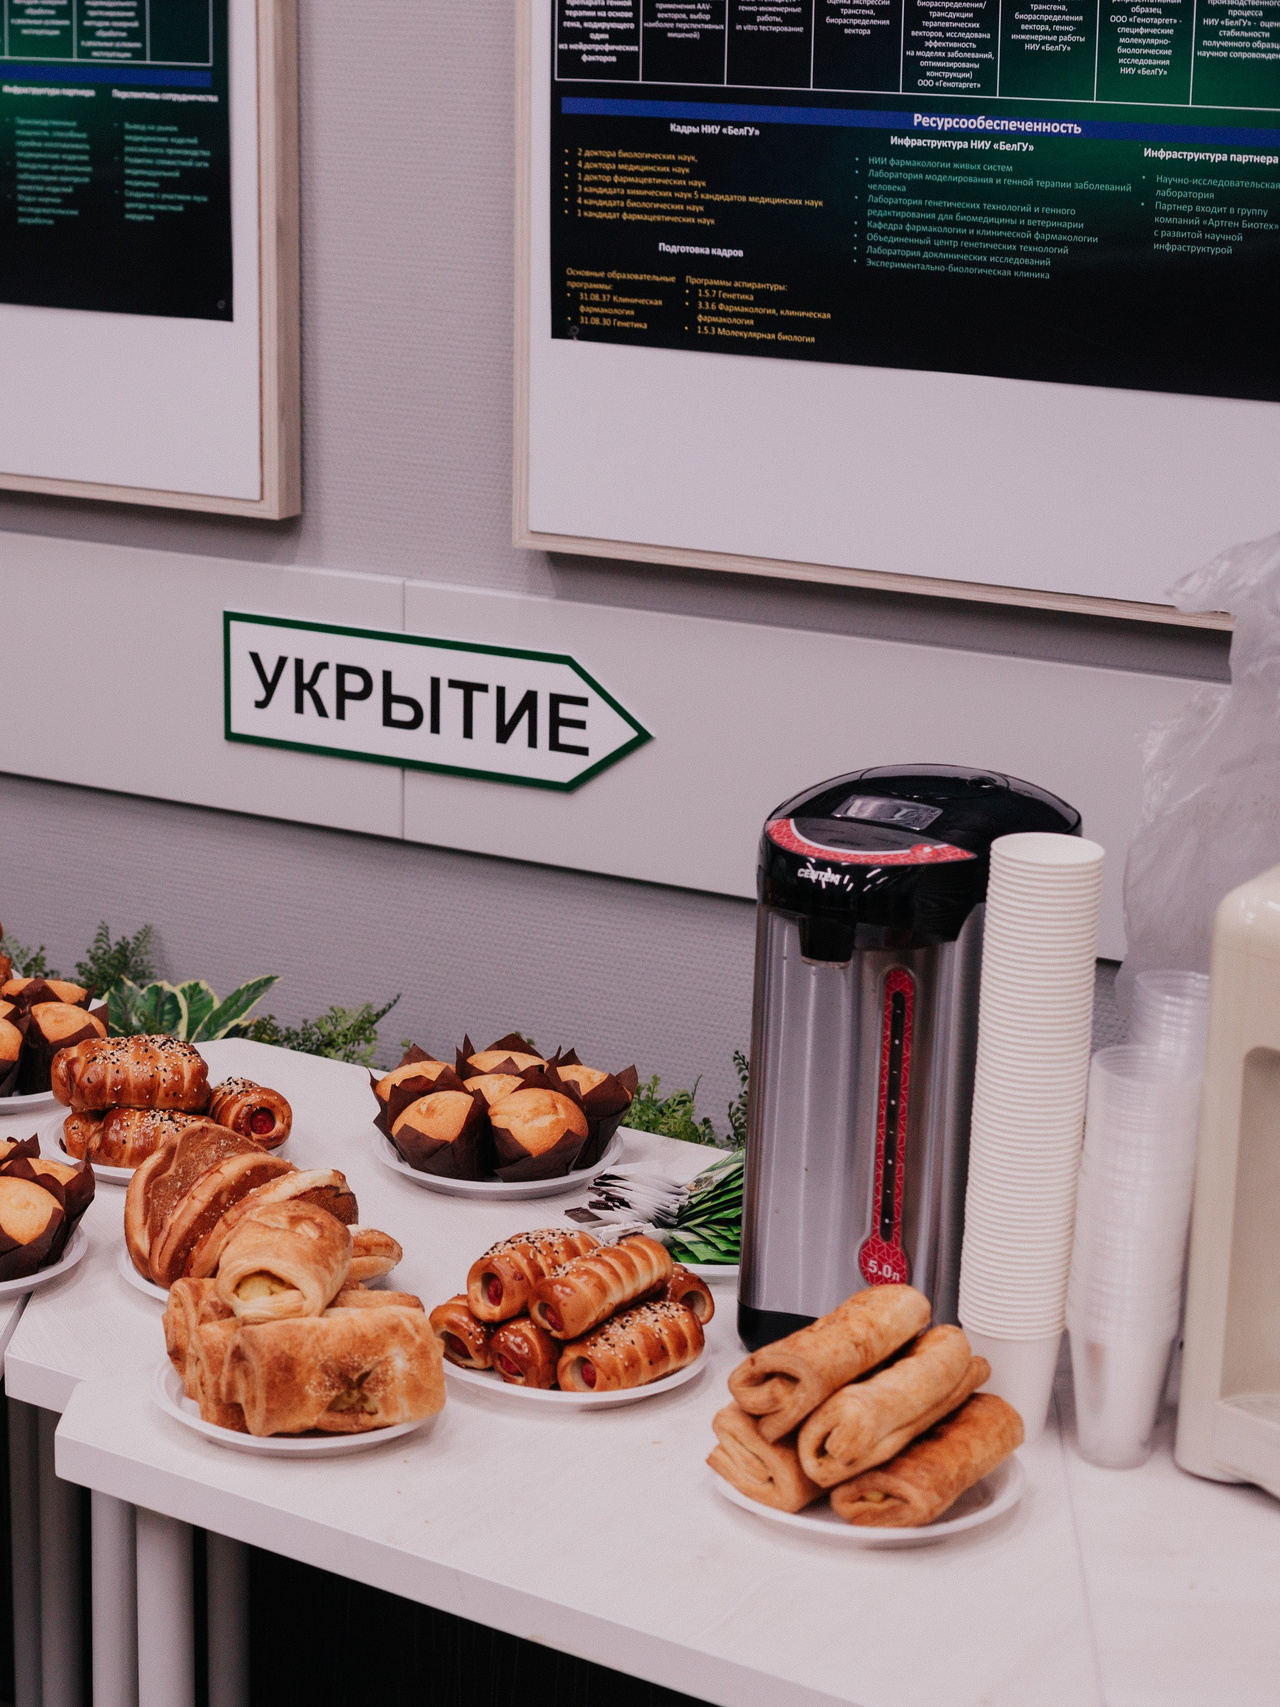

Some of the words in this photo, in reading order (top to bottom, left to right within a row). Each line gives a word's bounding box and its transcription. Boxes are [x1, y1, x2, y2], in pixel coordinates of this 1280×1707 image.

[840, 7, 876, 17] трансгена,
[916, 0, 987, 11] биораспределения/
[1030, 3, 1068, 13] трансгена,
[1130, 3, 1162, 16] образец
[928, 10, 974, 21] трансдукции
[1014, 10, 1083, 23] биораспределения
[1109, 13, 1128, 23] ООО
[1128, 13, 1178, 26] «Генотаргет»
[1227, 8, 1263, 18] процесса
[825, 14, 890, 27] биораспределения
[921, 19, 980, 30] терапевтических
[1202, 16, 1220, 26] НИУ
[1220, 17, 1252, 27] «БелГУ»
[843, 27, 871, 37] вектора
[910, 29, 944, 40] векторов,
[945, 30, 990, 40] исследована
[1020, 23, 1051, 33] вектора,
[1052, 23, 1076, 32] генно-
[1116, 24, 1174, 36] специфические
[1218, 27, 1270, 38] стабильности
[924, 37, 976, 50] эффективность
[1011, 33, 1058, 43] инженерные
[1058, 32, 1086, 44] работы
[1118, 36, 1171, 47] молекулярно-
[1202, 39, 1251, 49] полученного
[1024, 42, 1040, 52] НИУ
[1040, 42, 1071, 53] «БелГУ»
[1116, 44, 1172, 55] биологические
[915, 49, 946, 59] моделях
[946, 48, 994, 61] заболеваний,
[1196, 49, 1228, 60] научное
[919, 60, 980, 70] оптимизированы
[1118, 57, 1170, 67] исследования
[926, 68, 973, 81] конструкции)
[1119, 66, 1136, 76] НИУ
[1136, 66, 1168, 77] «БелГУ»
[917, 77, 934, 87] ООО
[934, 78, 981, 91] «Генотаргет»
[669, 122, 700, 135] Кадры
[700, 123, 720, 134] НИУ
[721, 124, 760, 135] «БелГУ»
[913, 113, 1082, 135] Ресурсообеспеченность
[890, 135, 968, 150] Инфраструктура
[970, 138, 992, 149] НИУ
[992, 139, 1034, 150] «БелГУ»
[1143, 147, 1228, 163] Инфраструктура
[1229, 153, 1279, 165] партнера
[868, 155, 887, 166] НИИ
[888, 156, 951, 169] фармакологии
[952, 162, 981, 170] живых
[982, 163, 1013, 172] систем
[868, 167, 923, 182] Лаборатория
[924, 173, 994, 185] моделирования
[1003, 176, 1034, 186] генной
[1035, 179, 1072, 190] терапии
[1074, 179, 1132, 192] заболеваний
[1156, 173, 1280, 189] Научно-исследовательская
[867, 183, 906, 192] человека
[1155, 187, 1214, 201] лаборатория
[867, 193, 922, 208] Лаборатория
[924, 199, 980, 209] генетических
[982, 202, 1032, 212] технологий
[1041, 206, 1076, 215] генного
[1154, 200, 1193, 214] Партнер
[1195, 204, 1227, 214] входит
[1236, 207, 1268, 218] группу
[867, 208, 936, 220] редактирования
[937, 213, 953, 222] для
[955, 212, 1017, 225] биомедицины
[1026, 218, 1084, 231] ветеринарии
[1154, 215, 1200, 225] компаний
[1202, 216, 1239, 229] «Артген
[1241, 218, 1279, 229] Биотех»
[866, 219, 903, 233] Кафедра
[904, 221, 967, 235] фармакологии
[976, 228, 1032, 239] клинической
[1033, 229, 1098, 243] фармакологии
[1160, 229, 1202, 239] развитой
[1204, 231, 1243, 243] научной
[866, 231, 931, 245] Объединенный
[933, 238, 958, 249] центр
[960, 240, 1016, 251] генетических
[1019, 244, 1068, 254] технологий
[1153, 241, 1232, 256] инфраструктурой
[658, 242, 710, 254] Подготовка
[710, 247, 744, 258] кадров
[866, 244, 921, 259] Лаборатория
[922, 250, 988, 262] доклинических
[989, 255, 1051, 266] исследований
[866, 257, 1012, 276] Экспериментально-биологическая
[1013, 269, 1050, 279] клиника
[685, 274, 732, 288] Программы
[733, 280, 787, 292] аспирантуры:
[698, 287, 716, 298] 1.5.7
[718, 289, 754, 301] Генетика
[697, 300, 717, 311] 3.3.6
[717, 301, 778, 317] Фармакология,
[779, 308, 831, 319] клиническая
[696, 312, 754, 325] фармакология
[697, 325, 716, 336] 1.5.3
[716, 326, 776, 341] Молекулярная
[776, 331, 816, 343] биология
[248, 651, 590, 757] УКРЫТИЕ
